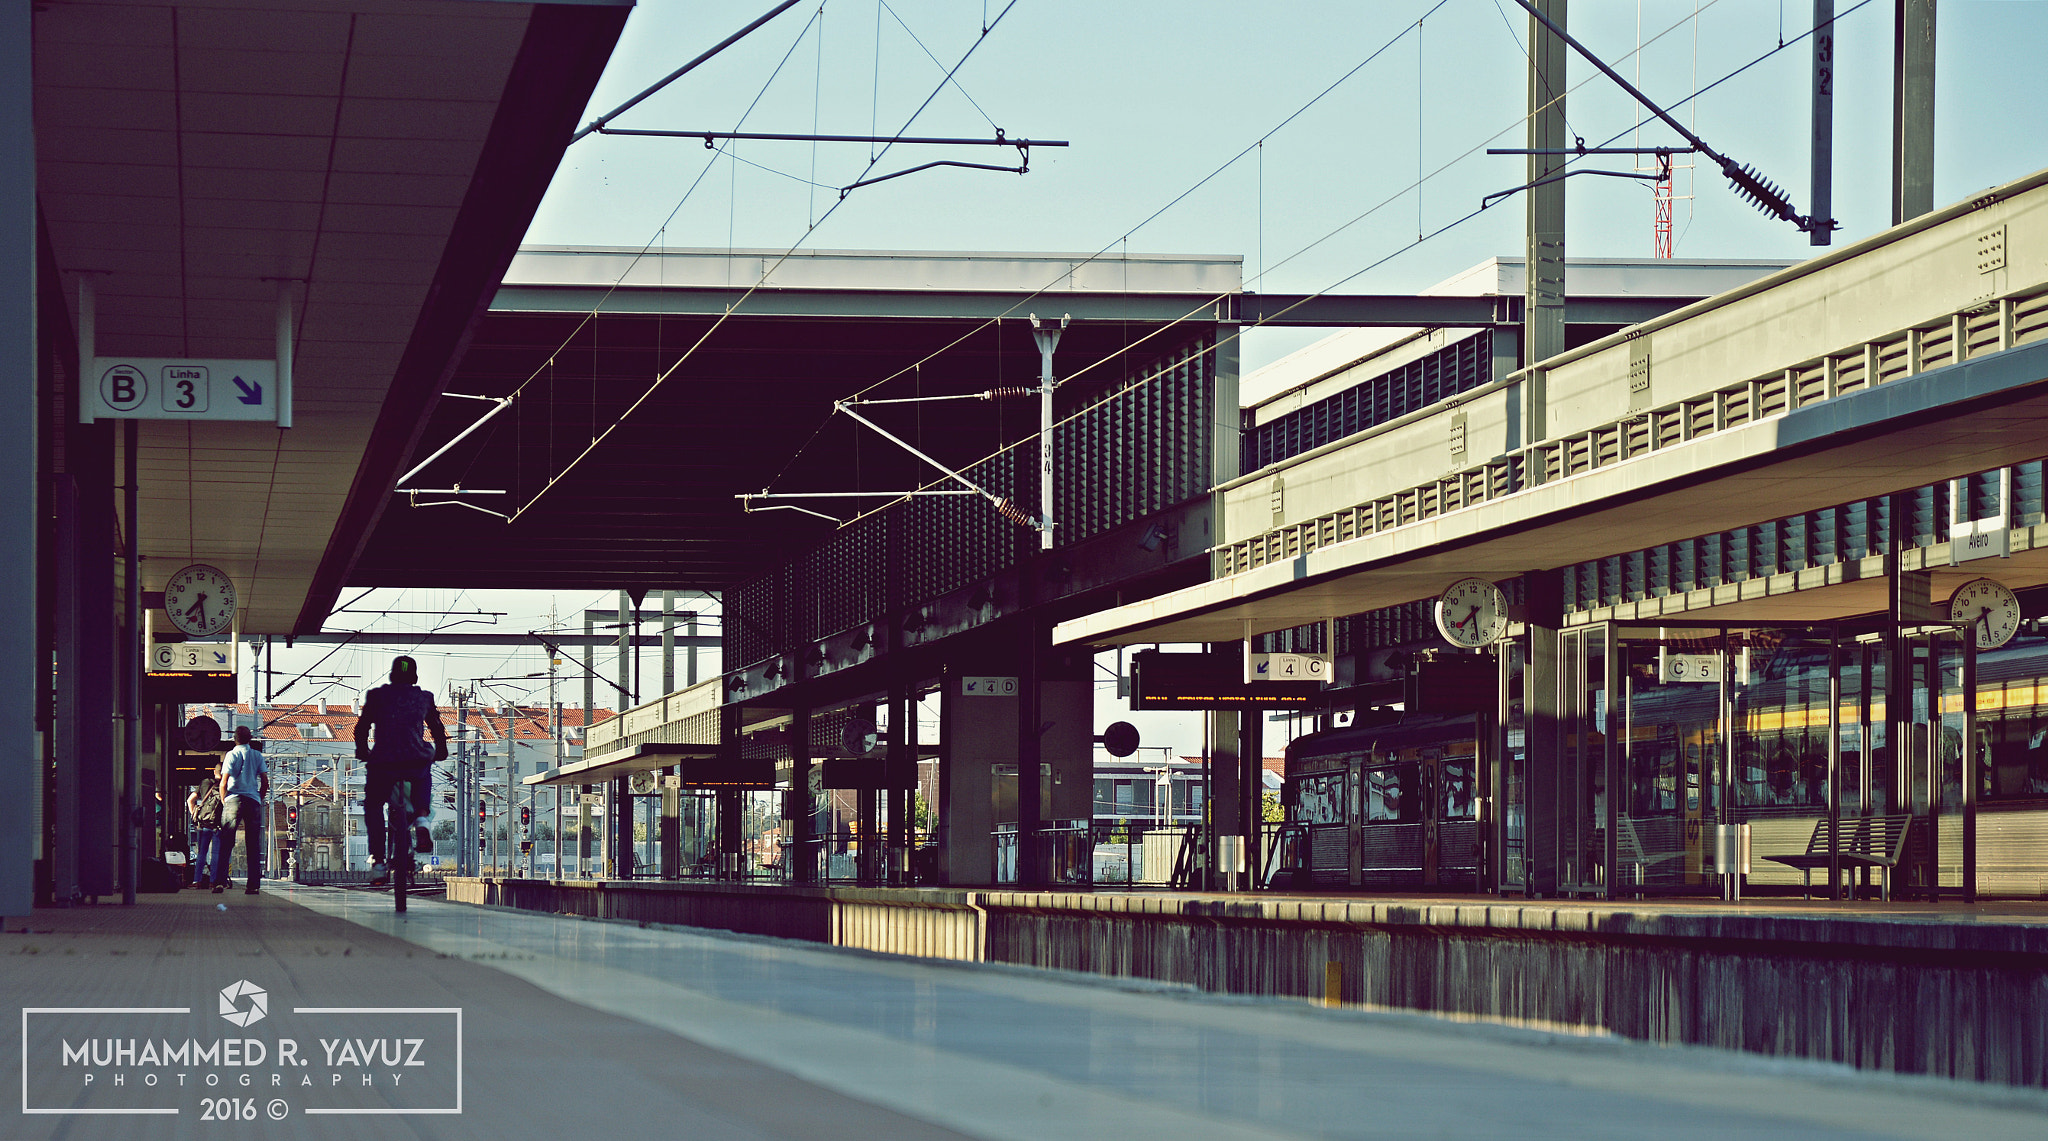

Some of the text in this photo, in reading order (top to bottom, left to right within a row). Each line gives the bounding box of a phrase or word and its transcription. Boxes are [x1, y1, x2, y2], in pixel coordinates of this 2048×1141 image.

[169, 369, 201, 379] Linha
[111, 375, 136, 403] B
[175, 379, 196, 409] 3
[1968, 532, 1989, 550] Aveiro
[186, 576, 192, 584] 11
[196, 573, 206, 581] 12
[176, 585, 186, 593] 10
[220, 586, 226, 594] 2
[1459, 589, 1465, 597] 11
[1469, 586, 1478, 594] 12
[1484, 589, 1487, 597] 1
[1980, 587, 1989, 595] 12
[1970, 590, 1976, 598] 11
[1995, 590, 1998, 598] 1
[172, 596, 178, 604] 9
[224, 598, 230, 606] 3
[1450, 597, 1459, 605] 10
[1961, 599, 1970, 607] 10
[2003, 599, 2009, 607] 2
[1957, 610, 1963, 618] 9
[197, 621, 203, 629] 6
[2002, 622, 2008, 630] 4
[1981, 634, 1987, 642] 6
[160, 650, 171, 663] C
[188, 652, 197, 666] 3
[1285, 663, 1294, 676] 4
[1310, 660, 1321, 673] C
[1673, 662, 1684, 675] C
[1701, 665, 1710, 677] 5
[987, 683, 994, 693] 4
[1005, 682, 1013, 691] D
